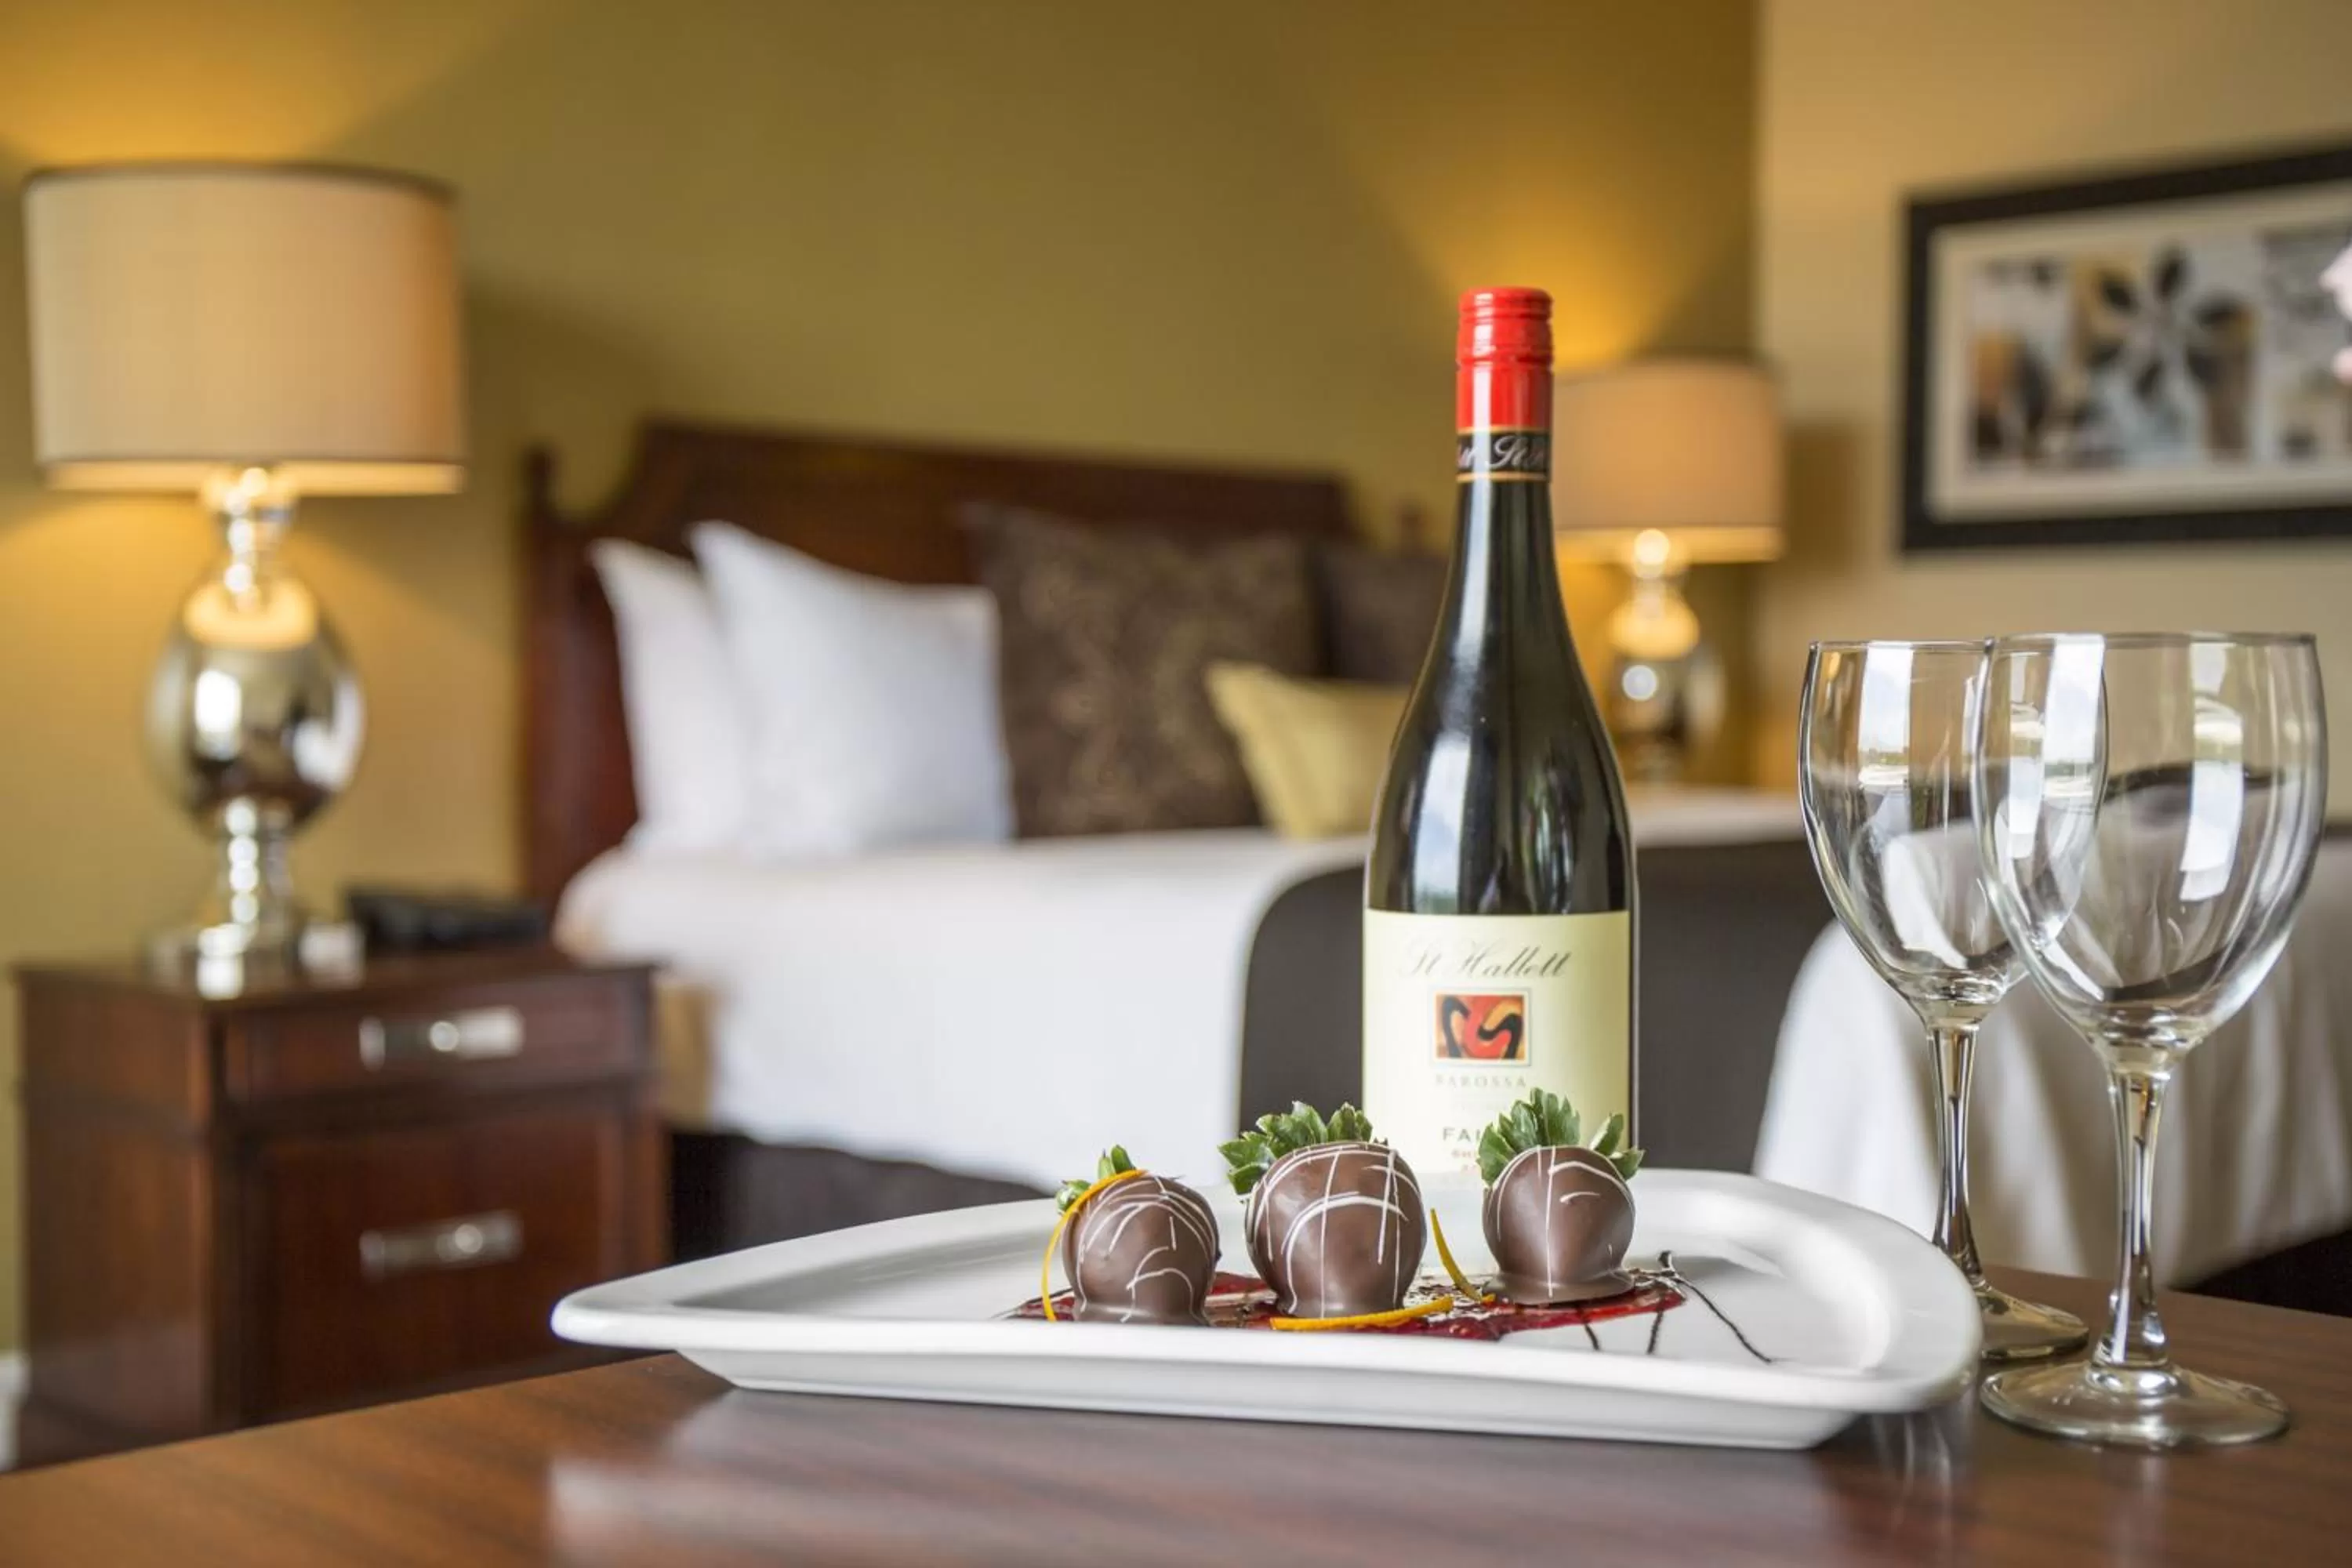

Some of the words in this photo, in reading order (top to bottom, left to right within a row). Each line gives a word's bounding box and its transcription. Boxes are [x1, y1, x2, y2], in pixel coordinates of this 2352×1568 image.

[1397, 938, 1443, 978] St
[1453, 938, 1573, 978] Hallett
[1435, 1074, 1527, 1088] BAROSSA
[1442, 1126, 1481, 1142] FAI
